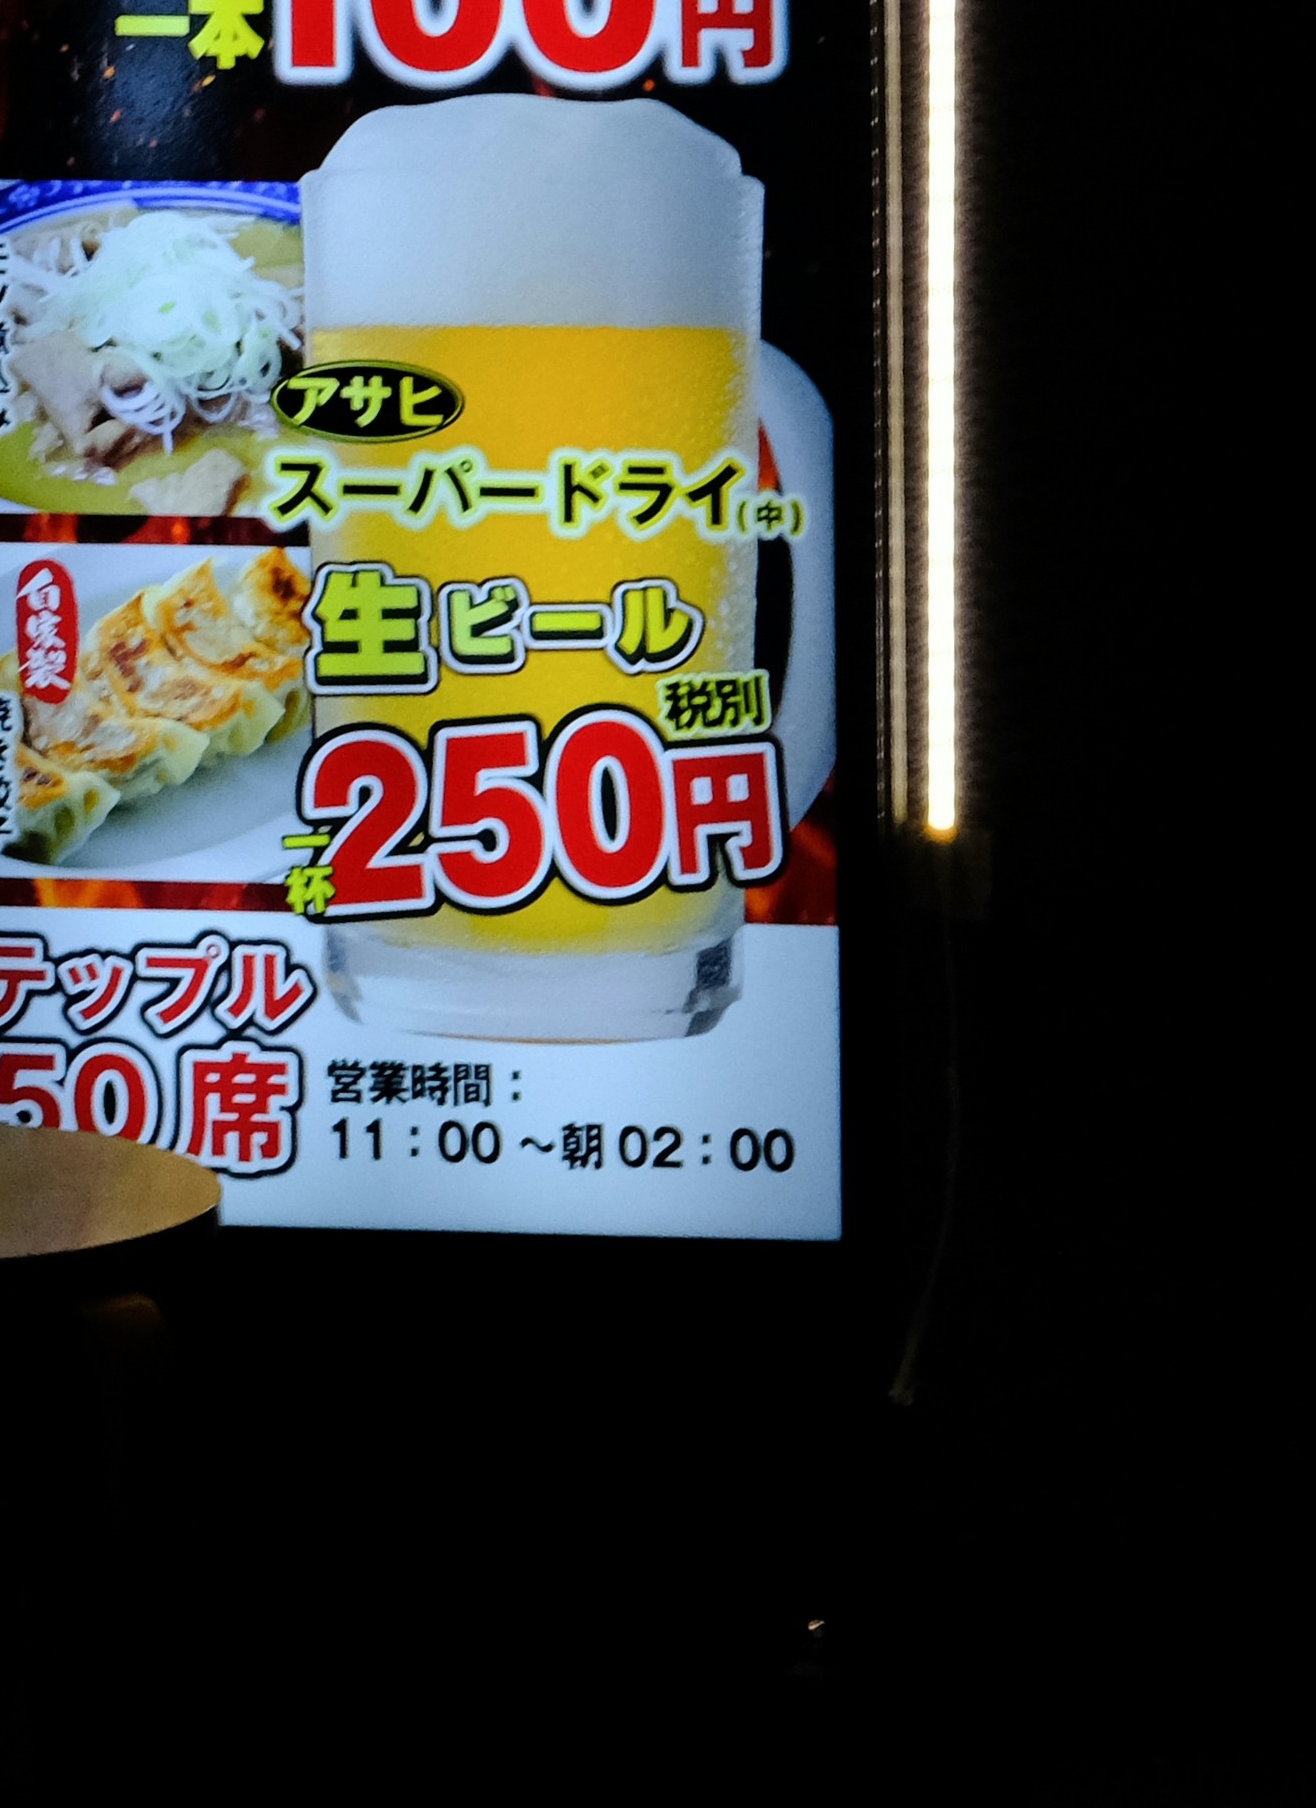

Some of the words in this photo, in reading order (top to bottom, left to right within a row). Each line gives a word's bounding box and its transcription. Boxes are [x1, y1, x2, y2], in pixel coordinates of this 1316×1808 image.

[286, 375, 444, 427] アサヒ
[273, 458, 743, 527] スーパードライ
[312, 569, 693, 686] 生ビール
[664, 675, 766, 729] 税別
